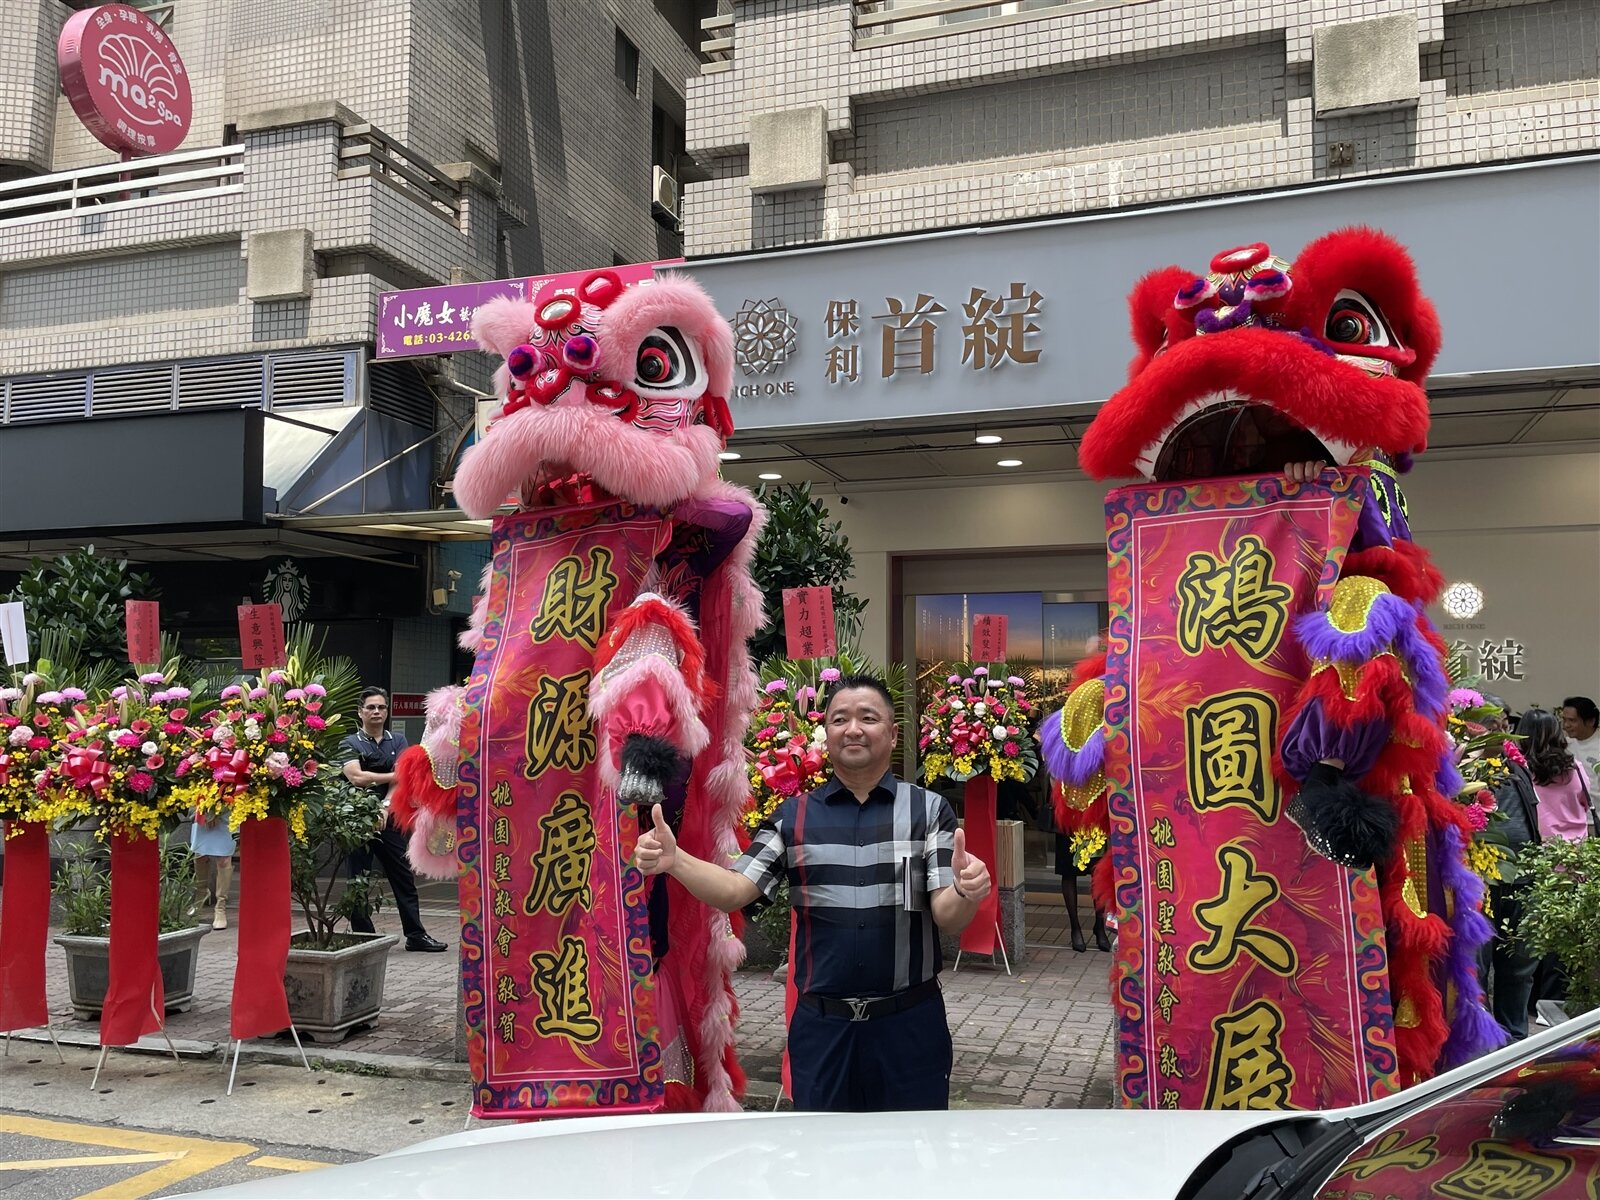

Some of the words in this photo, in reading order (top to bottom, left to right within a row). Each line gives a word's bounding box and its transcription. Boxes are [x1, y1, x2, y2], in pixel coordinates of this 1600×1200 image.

[824, 299, 860, 383] 保利
[871, 282, 1044, 378] 首綻
[731, 384, 760, 398] ICH
[764, 381, 795, 396] ONE
[250, 607, 265, 667] 生意興隆
[522, 544, 619, 1045] 財源廣進
[1175, 533, 1299, 1110] 鴻圖大展
